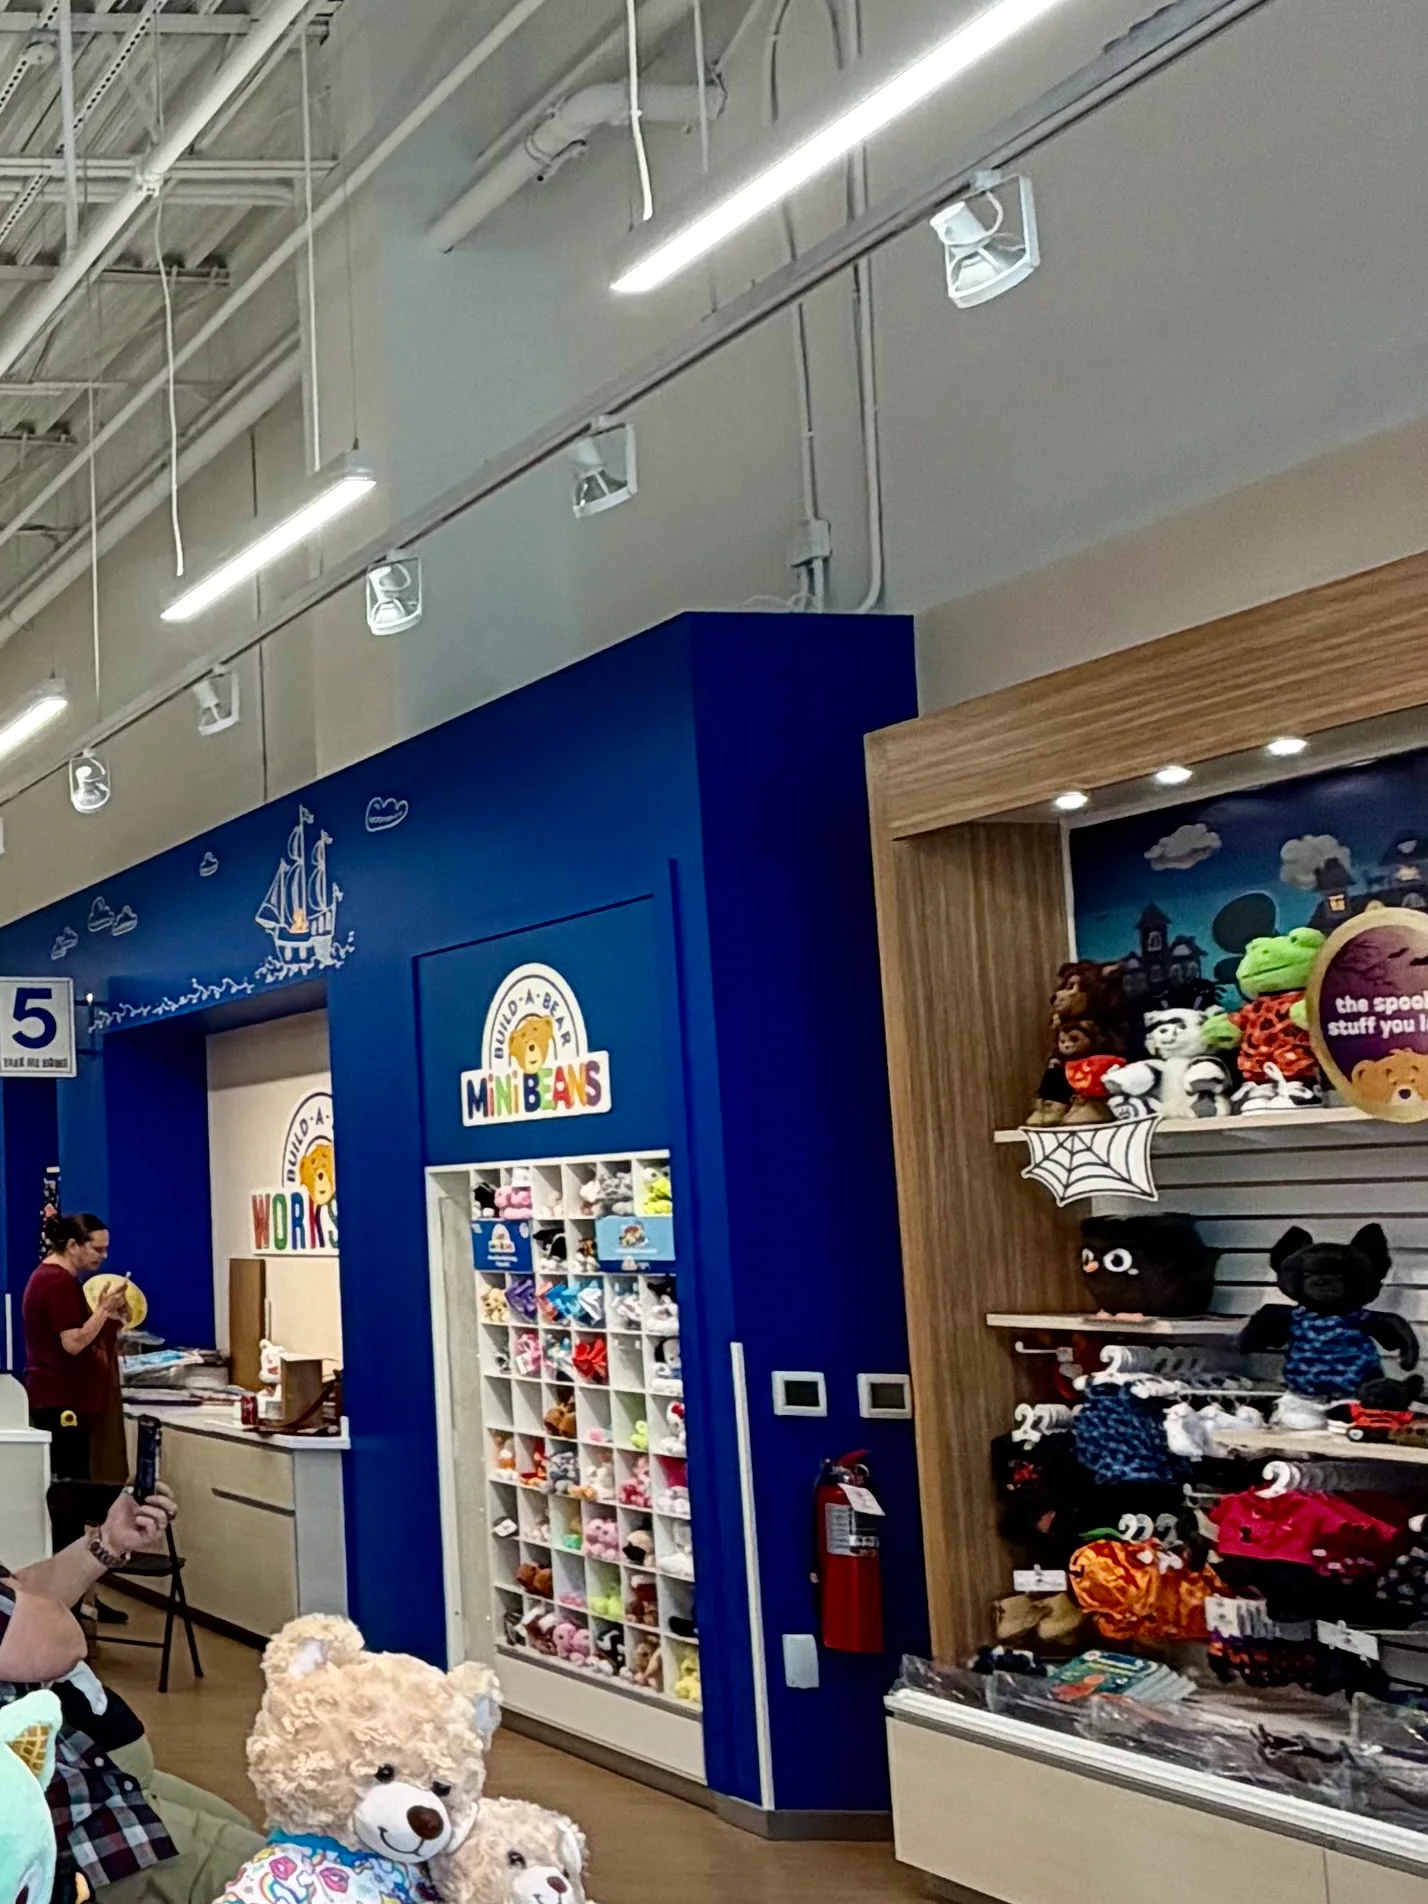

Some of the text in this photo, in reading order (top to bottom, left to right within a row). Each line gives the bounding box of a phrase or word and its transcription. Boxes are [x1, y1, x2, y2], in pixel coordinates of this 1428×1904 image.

[12, 988, 57, 1049] 5
[1335, 995, 1369, 1014] the
[1328, 1016, 1376, 1036] stuff
[1380, 1019, 1415, 1039] you
[523, 1060, 602, 1112] BEANS
